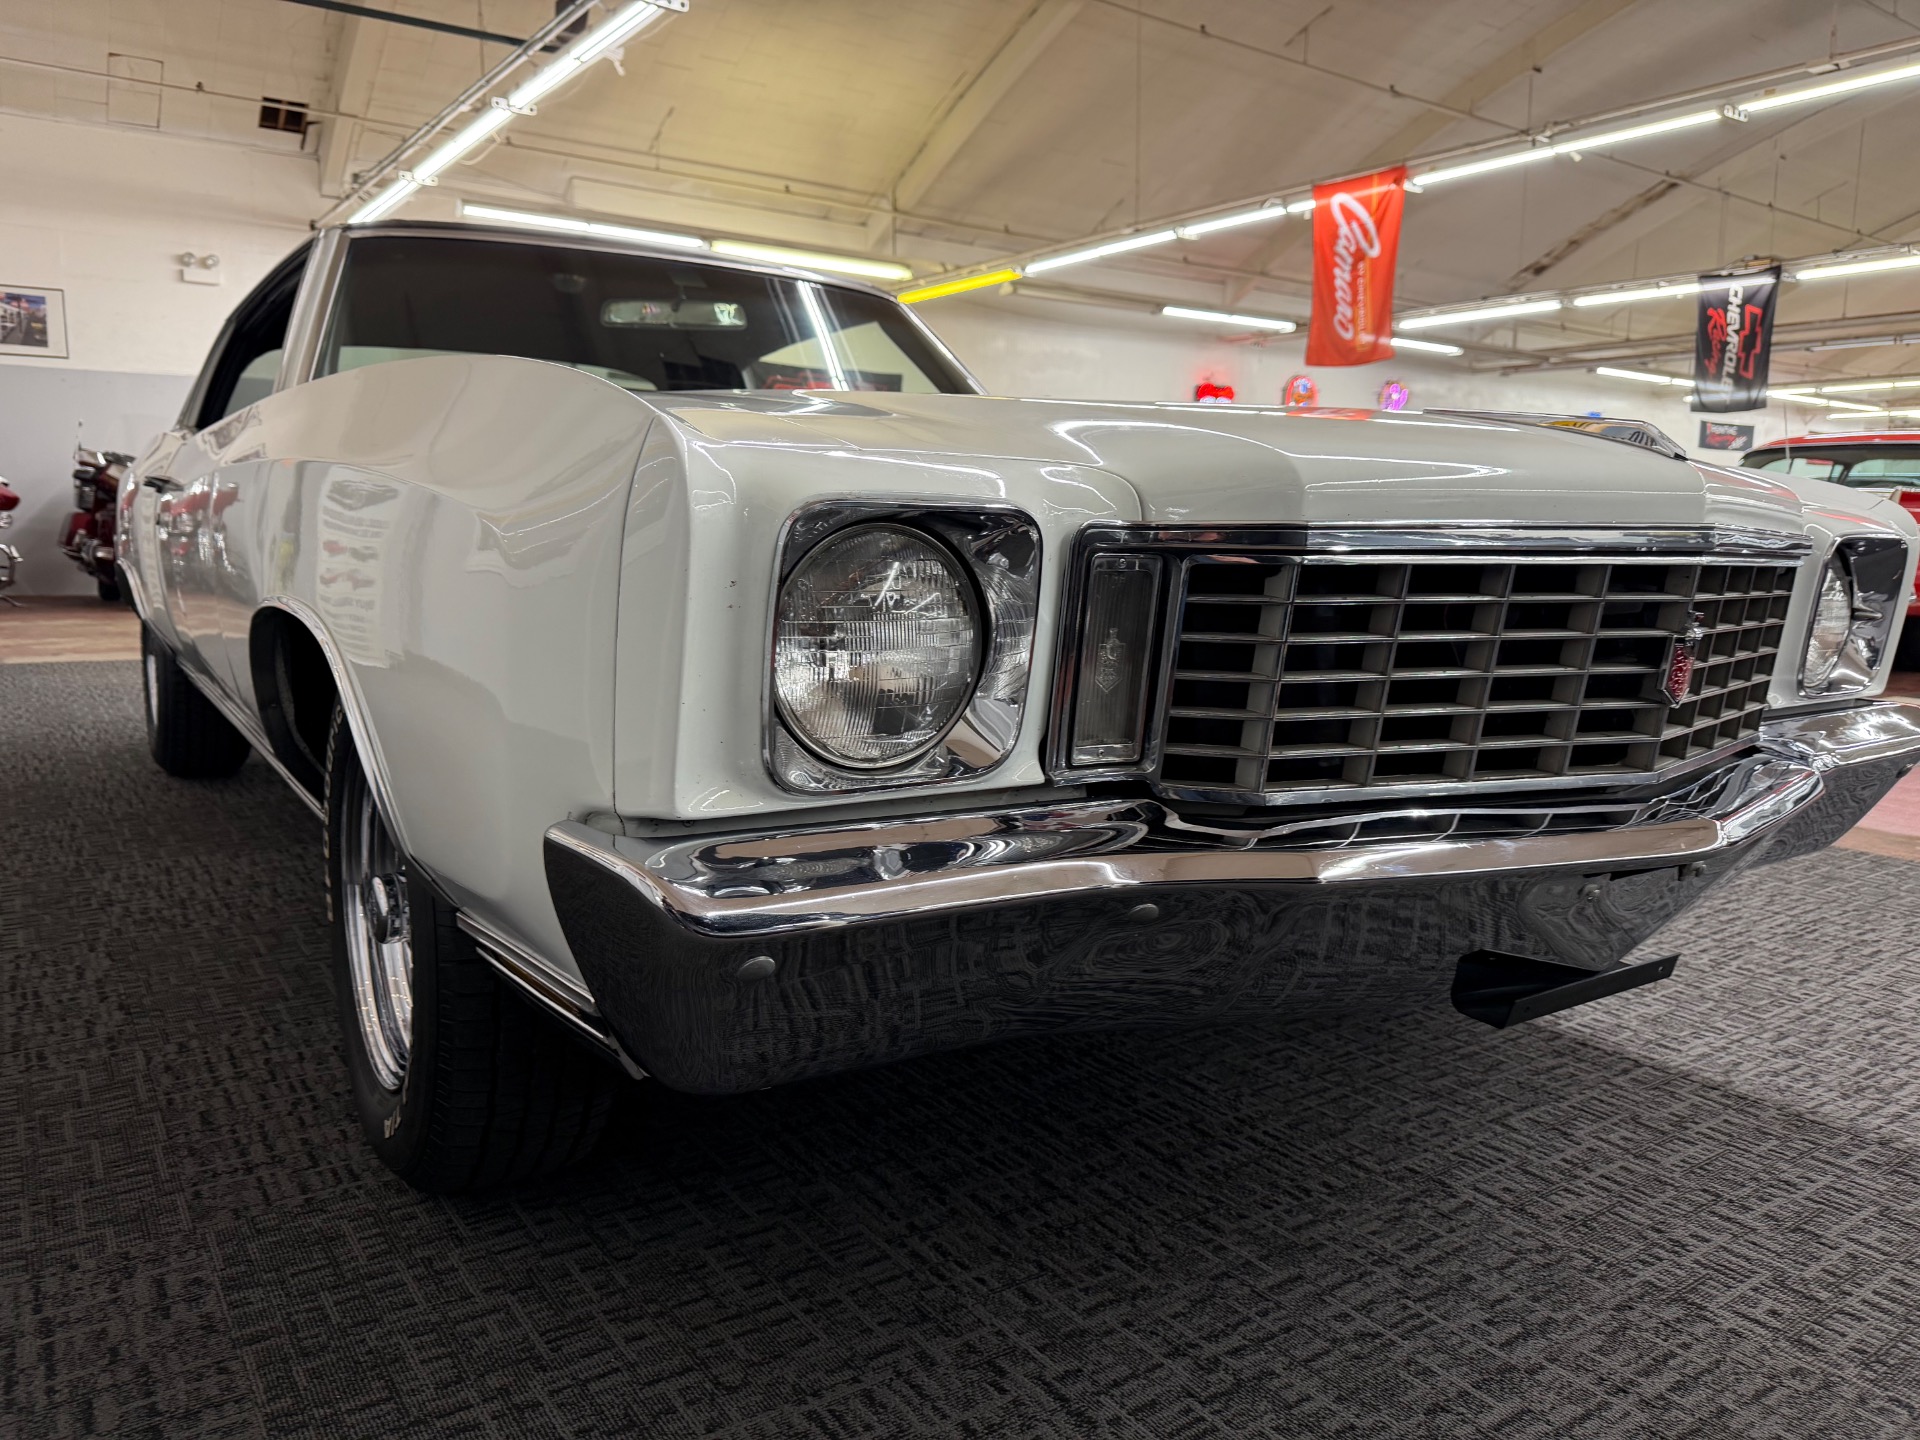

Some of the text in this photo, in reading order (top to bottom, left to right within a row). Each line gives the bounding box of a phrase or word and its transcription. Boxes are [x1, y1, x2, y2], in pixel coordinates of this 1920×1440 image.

[1331, 193, 1380, 340] Camaro
[1704, 307, 1727, 376] Racing
[1721, 284, 1743, 404] CHEVROLET
